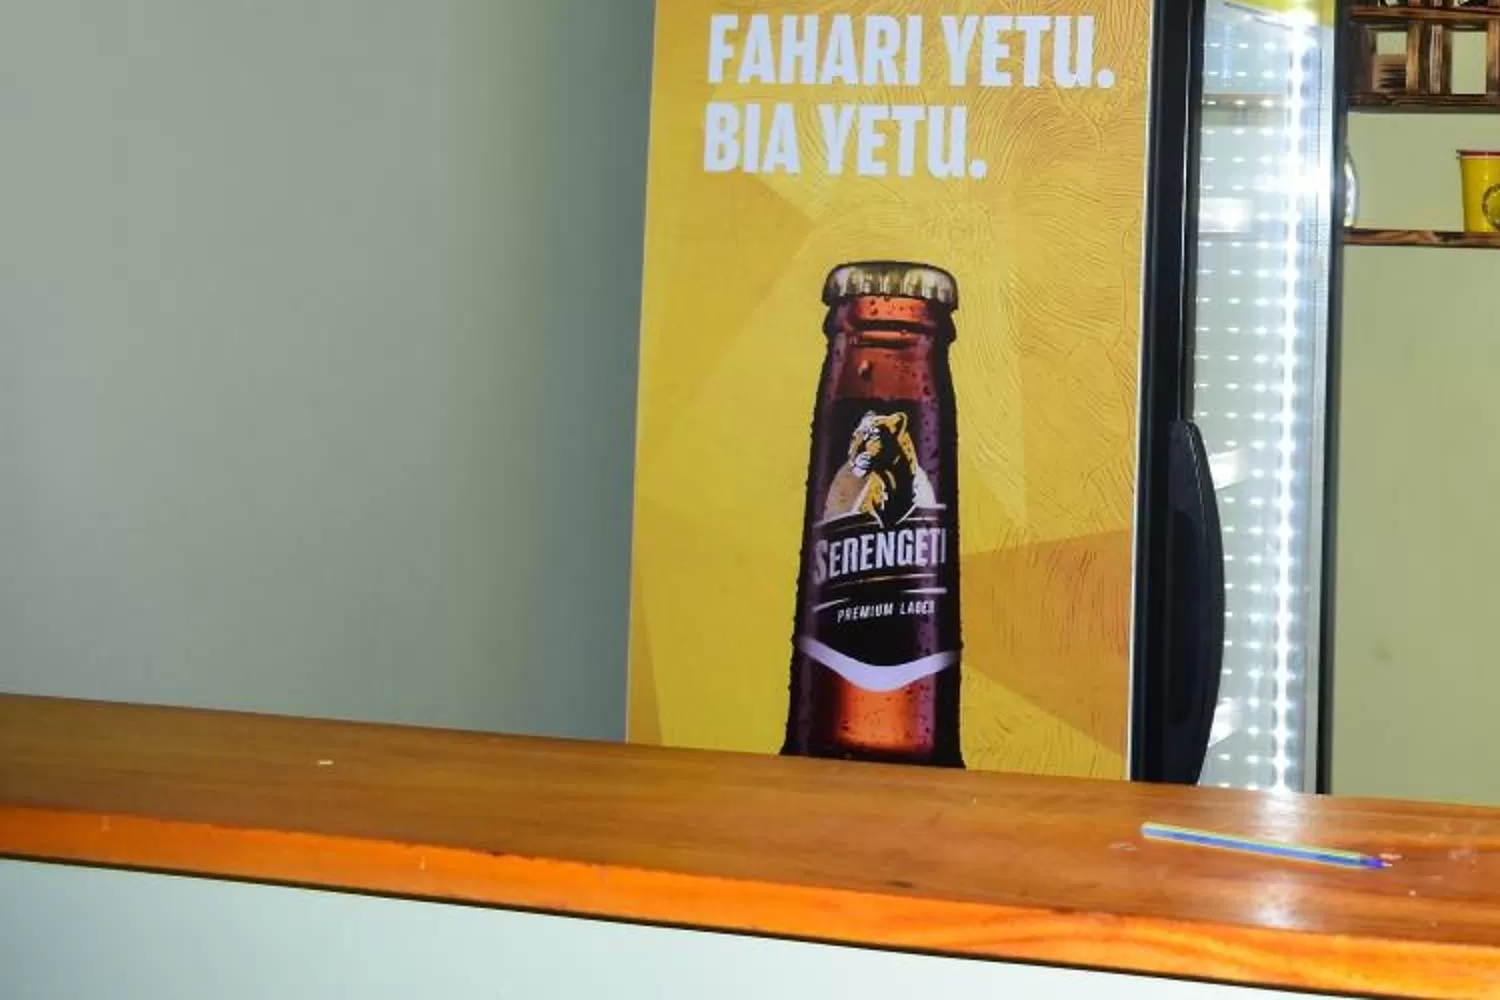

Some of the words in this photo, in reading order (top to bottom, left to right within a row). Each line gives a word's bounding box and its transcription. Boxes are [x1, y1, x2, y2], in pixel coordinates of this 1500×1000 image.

[707, 13, 922, 86] FAHARI
[942, 15, 1117, 89] YETU.
[703, 102, 801, 174] BIA
[819, 104, 988, 179] YETU.
[813, 528, 947, 585] SERENGETI
[837, 602, 894, 623] PREMIUM
[900, 600, 936, 616] LAGER
